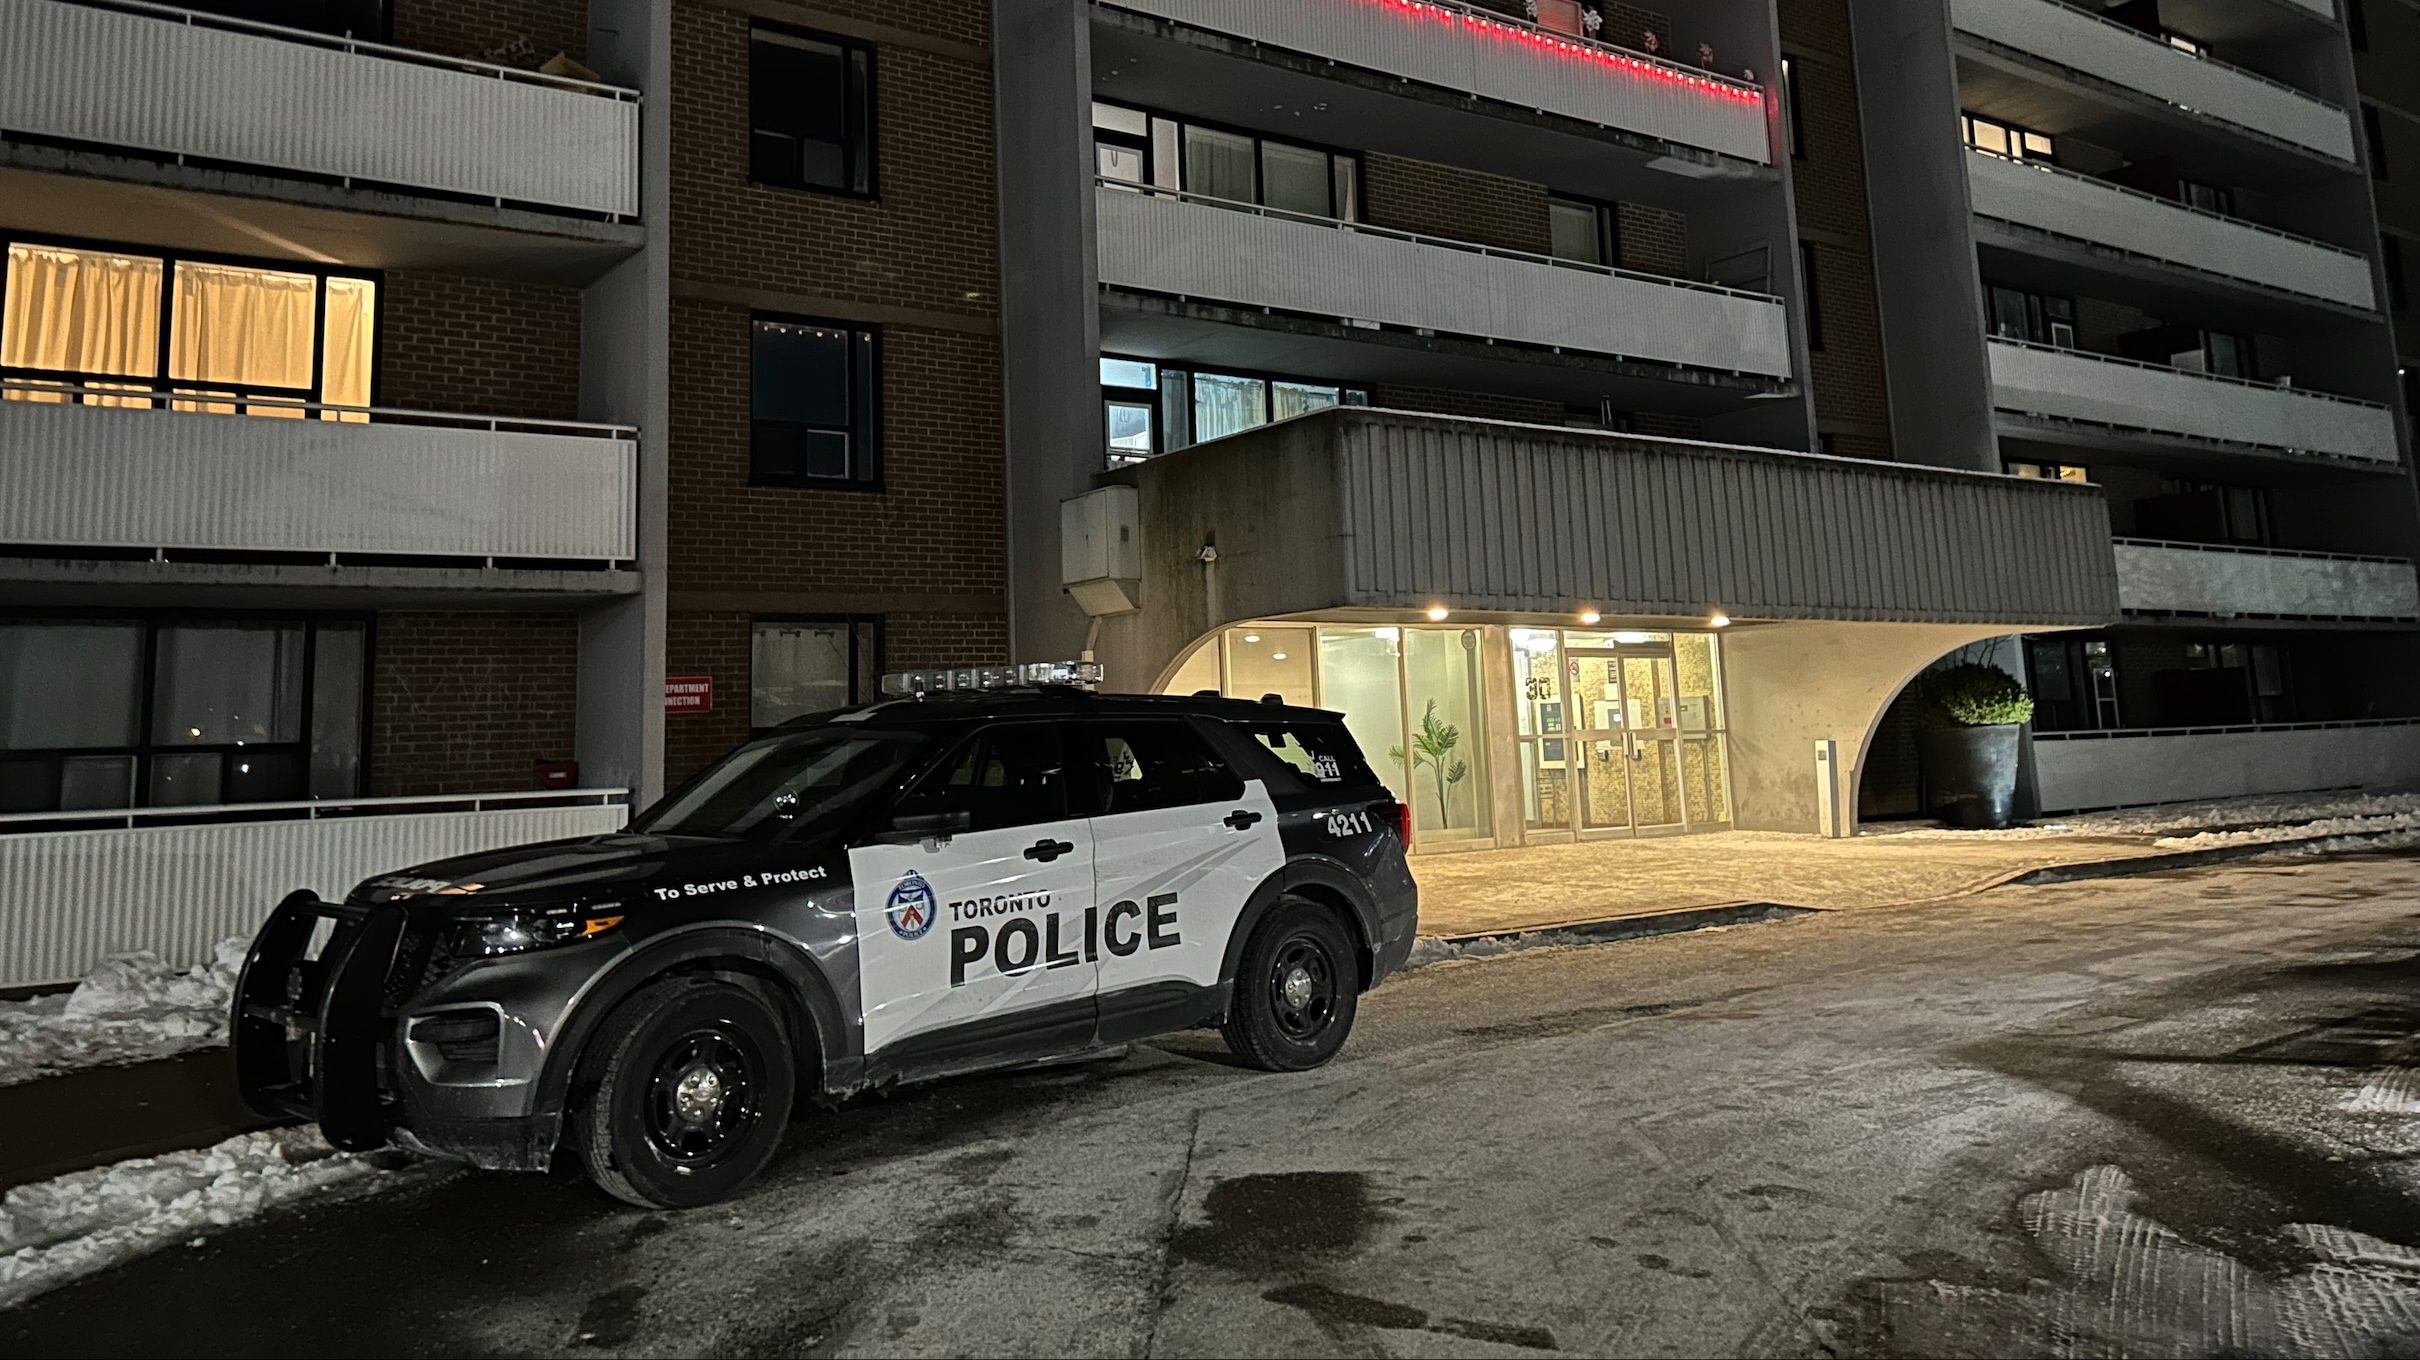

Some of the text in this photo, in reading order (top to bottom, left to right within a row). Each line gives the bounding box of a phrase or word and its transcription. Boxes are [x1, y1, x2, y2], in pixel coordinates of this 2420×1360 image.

[665, 683, 709, 694] EPARTMENT
[1327, 811, 1373, 837] 4211
[654, 865, 827, 901] To Serve & Protect
[949, 889, 1051, 921] TORONTO
[950, 891, 1182, 988] POLICE
